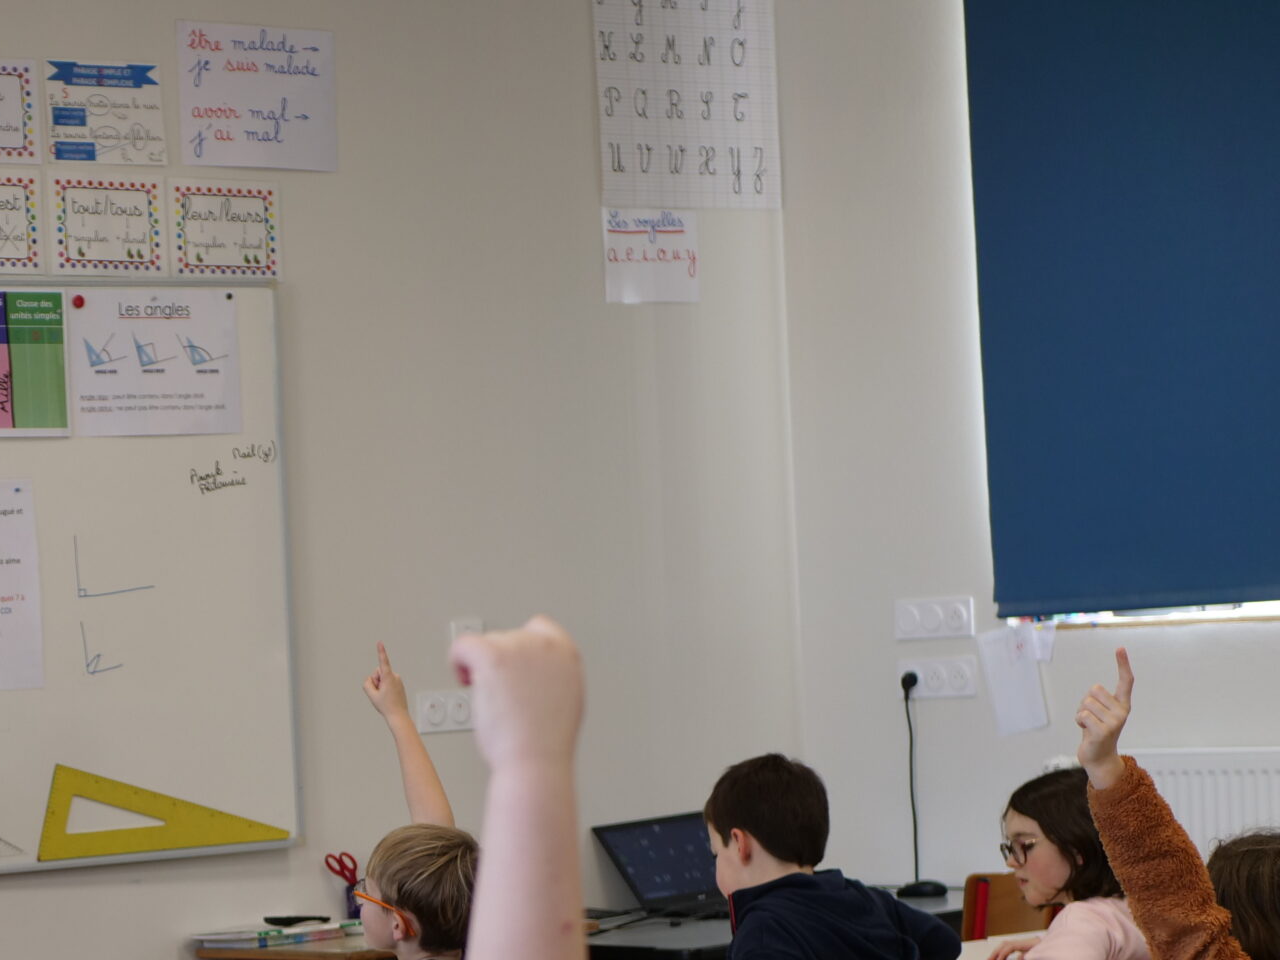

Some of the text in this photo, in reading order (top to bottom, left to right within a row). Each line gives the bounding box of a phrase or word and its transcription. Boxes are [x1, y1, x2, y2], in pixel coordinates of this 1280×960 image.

[188, 29, 298, 54] être malade
[629, 32, 644, 62] L
[660, 34, 681, 64] M
[698, 36, 715, 66] N
[730, 38, 746, 66] O
[188, 54, 320, 88] je suis malade
[192, 97, 290, 122] avoir mal
[604, 86, 621, 116] P
[634, 88, 648, 119] Q
[666, 89, 684, 119] R
[190, 123, 236, 158] j'ai
[244, 118, 284, 143] mal
[608, 142, 626, 172] U
[637, 143, 653, 173] V
[666, 144, 686, 174] W
[698, 145, 716, 175] X
[729, 146, 741, 194] Y
[608, 210, 684, 244] Les voyelles
[608, 247, 618, 262] a
[686, 248, 696, 278] y
[16, 300, 52, 308] Classe des
[118, 302, 191, 319] Les angles
